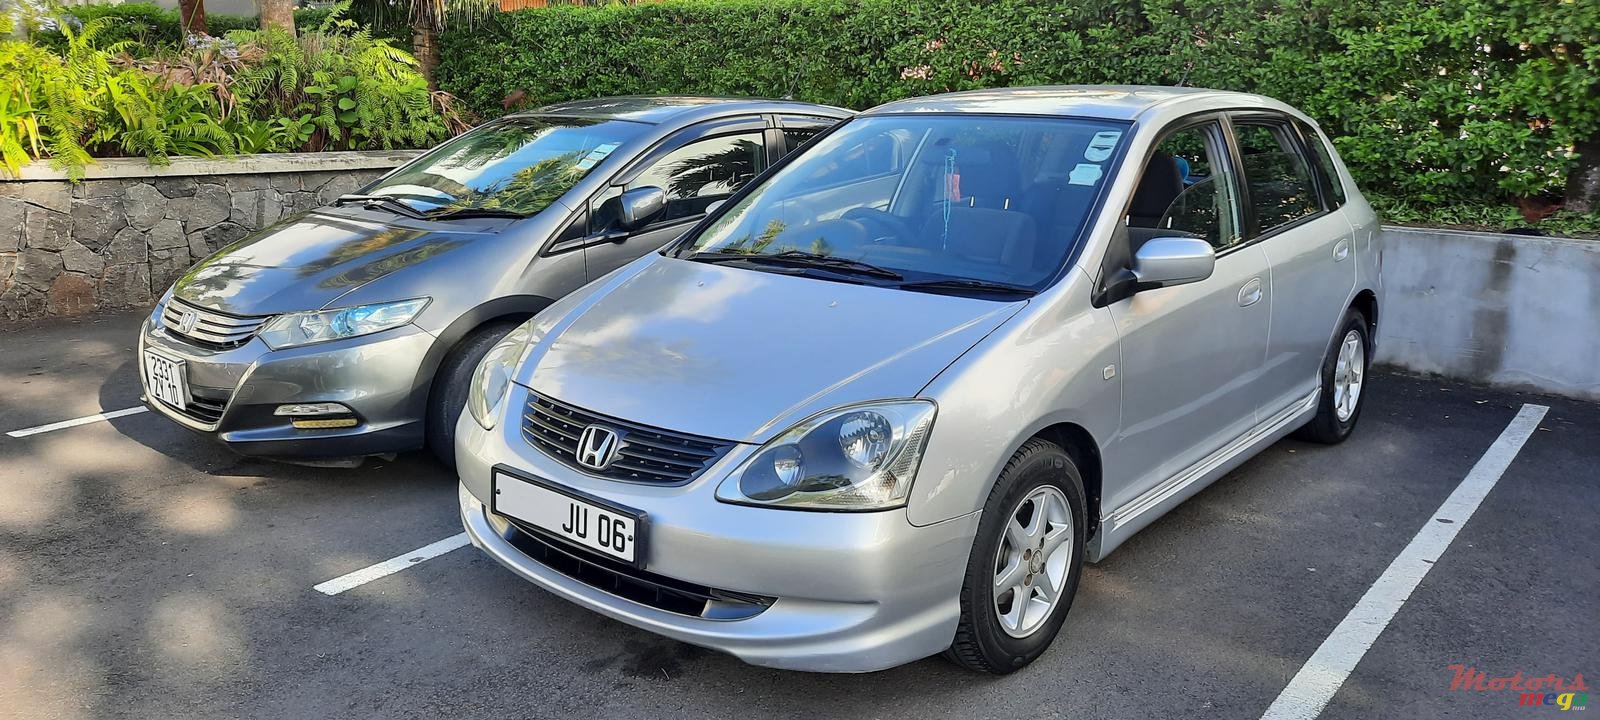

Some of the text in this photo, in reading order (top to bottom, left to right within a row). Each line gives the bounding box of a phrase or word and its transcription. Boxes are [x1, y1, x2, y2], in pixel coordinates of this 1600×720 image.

[151, 355, 174, 384] 2331
[168, 382, 179, 405] 10
[562, 502, 626, 553] JU 06
